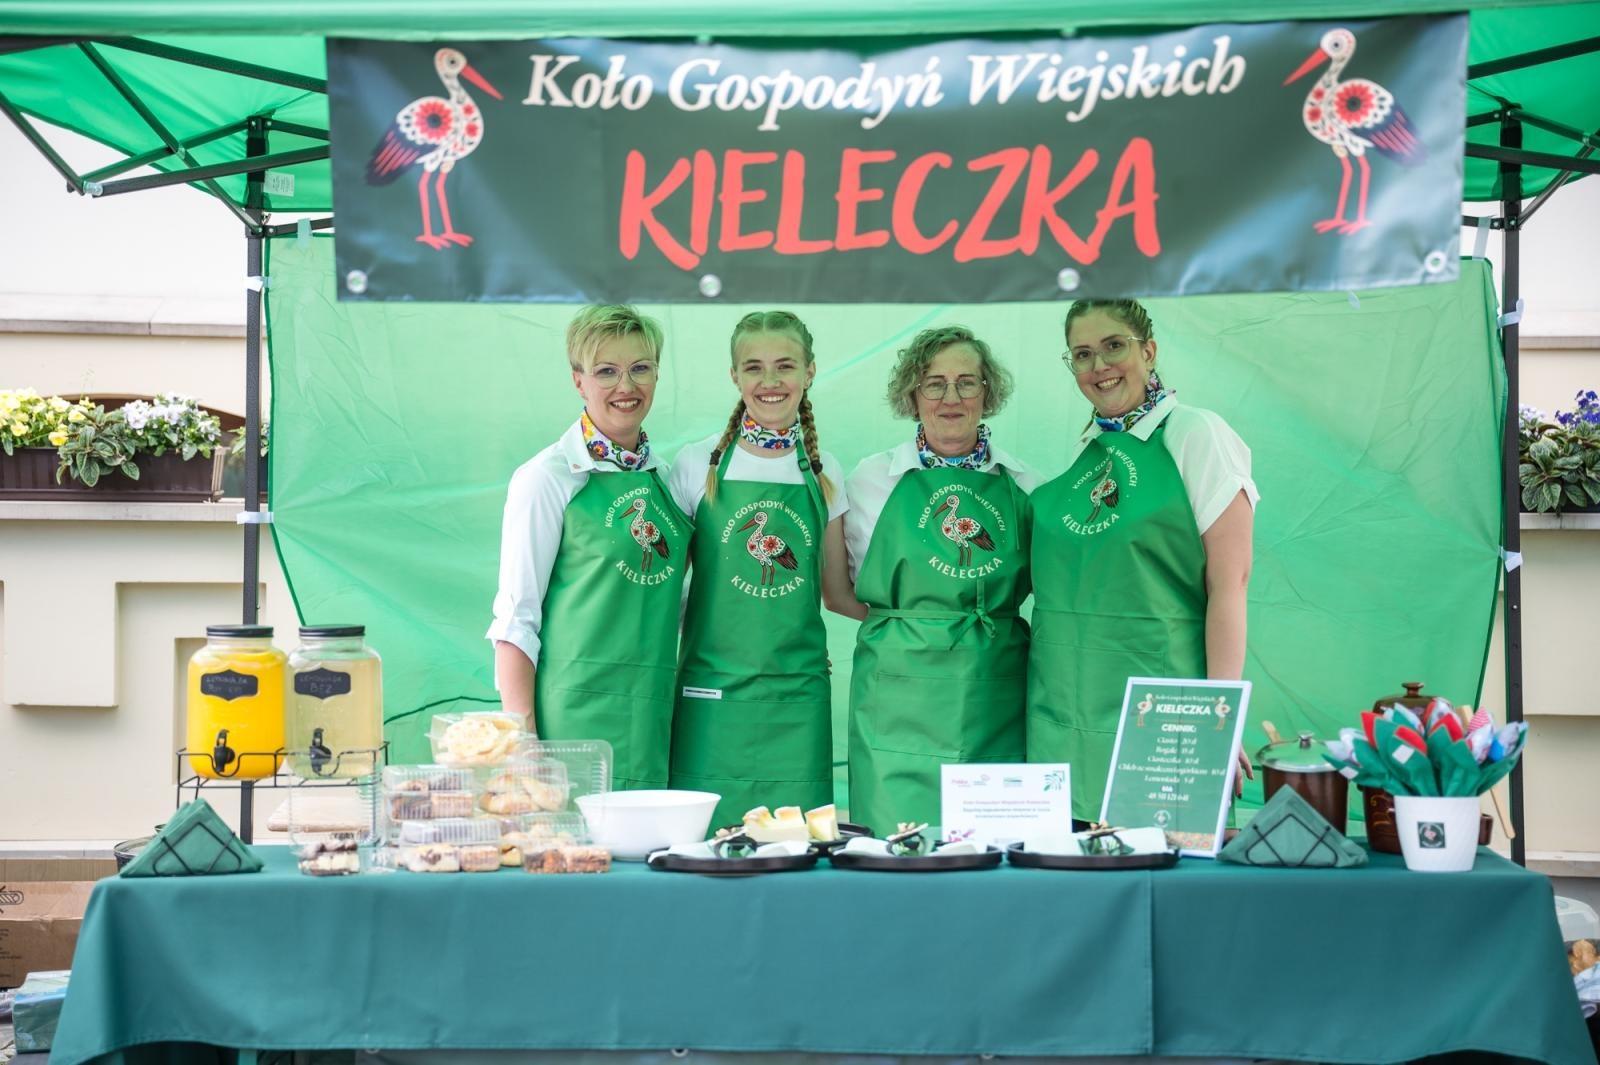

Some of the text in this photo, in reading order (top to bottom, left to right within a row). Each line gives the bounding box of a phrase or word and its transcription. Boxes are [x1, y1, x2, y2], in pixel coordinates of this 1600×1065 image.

[522, 35, 1247, 131] Koło Gospodyń Wiejskich
[620, 137, 1161, 271] KIELECZKA
[613, 487, 652, 508] GOSPOD
[974, 494, 1006, 531] WIEJSKICH
[1062, 513, 1120, 535] KIELECZKA
[784, 507, 812, 546] WIEJSKICH
[616, 560, 675, 585] KIELECZKA
[928, 556, 1003, 579] KIELECZKA
[731, 575, 805, 598] KIELECZKA
[1155, 703, 1211, 716] KIELECZKA
